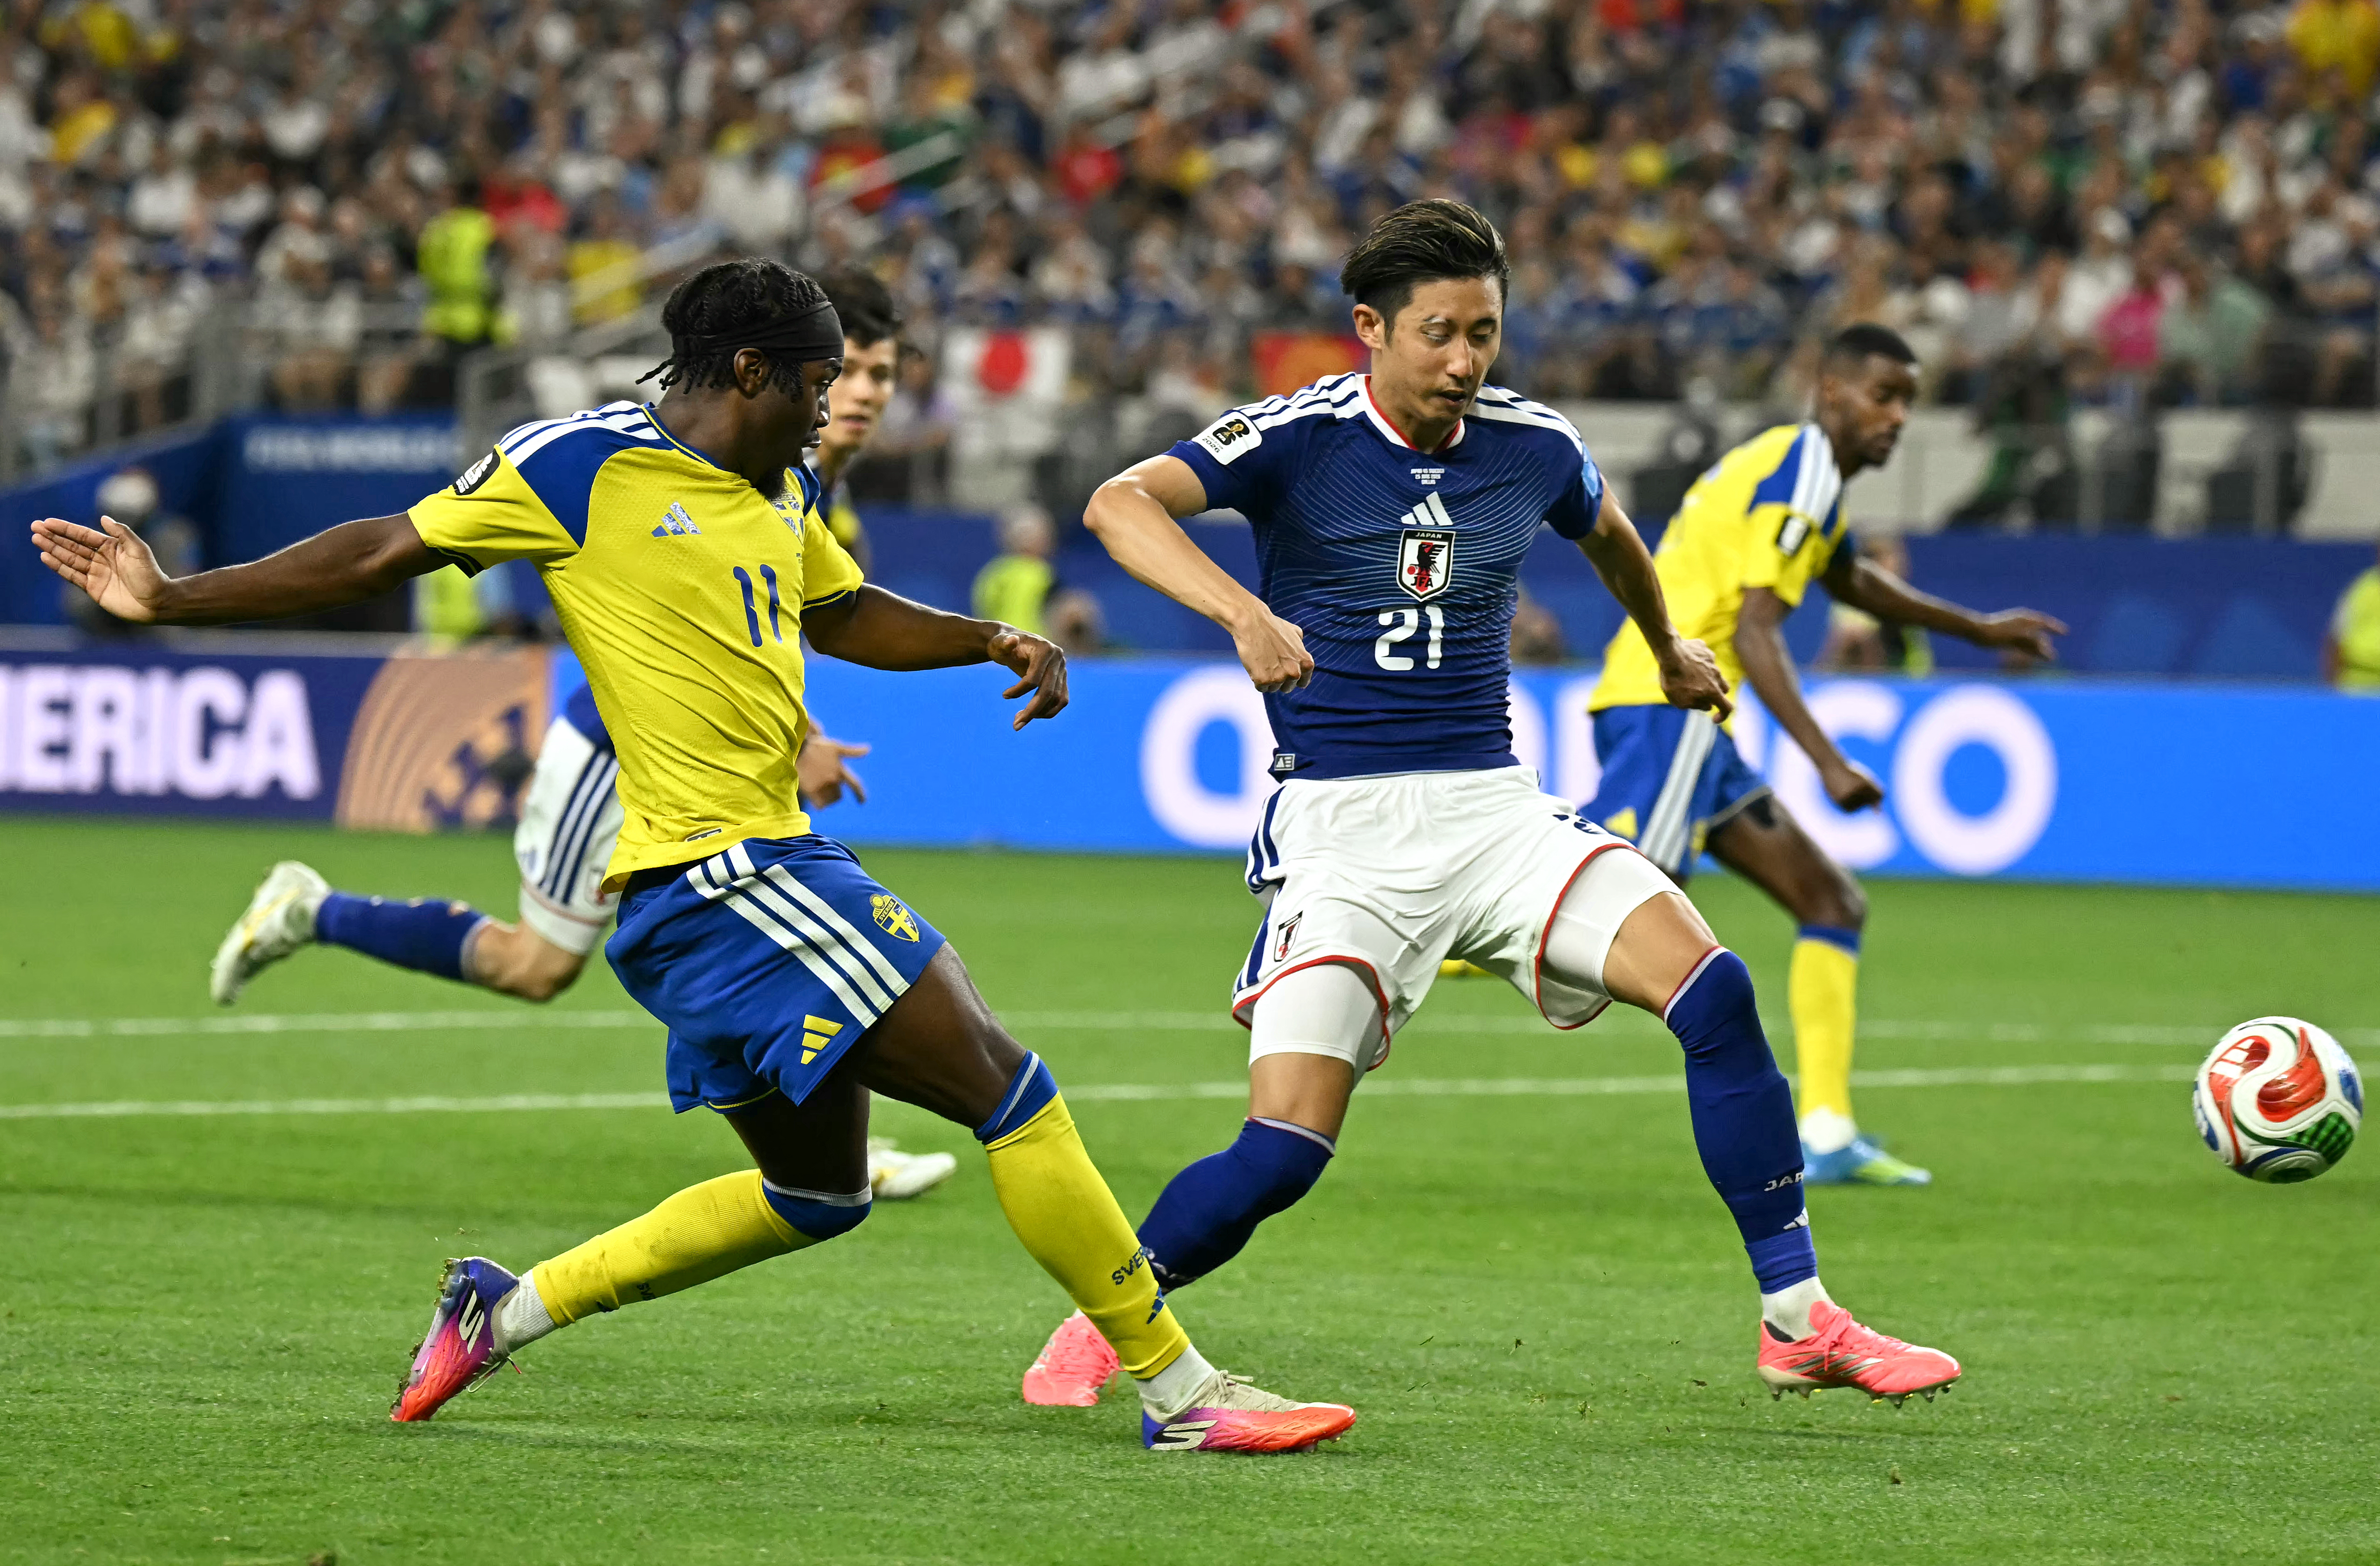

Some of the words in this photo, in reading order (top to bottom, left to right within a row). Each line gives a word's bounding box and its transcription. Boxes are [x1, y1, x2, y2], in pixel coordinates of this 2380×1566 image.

[1202, 438, 1220, 453] 2026
[1410, 576, 1433, 588] JFA
[733, 564, 783, 648] 11
[1375, 604, 1444, 671] 21
[879, 900, 894, 921] SVERIGE
